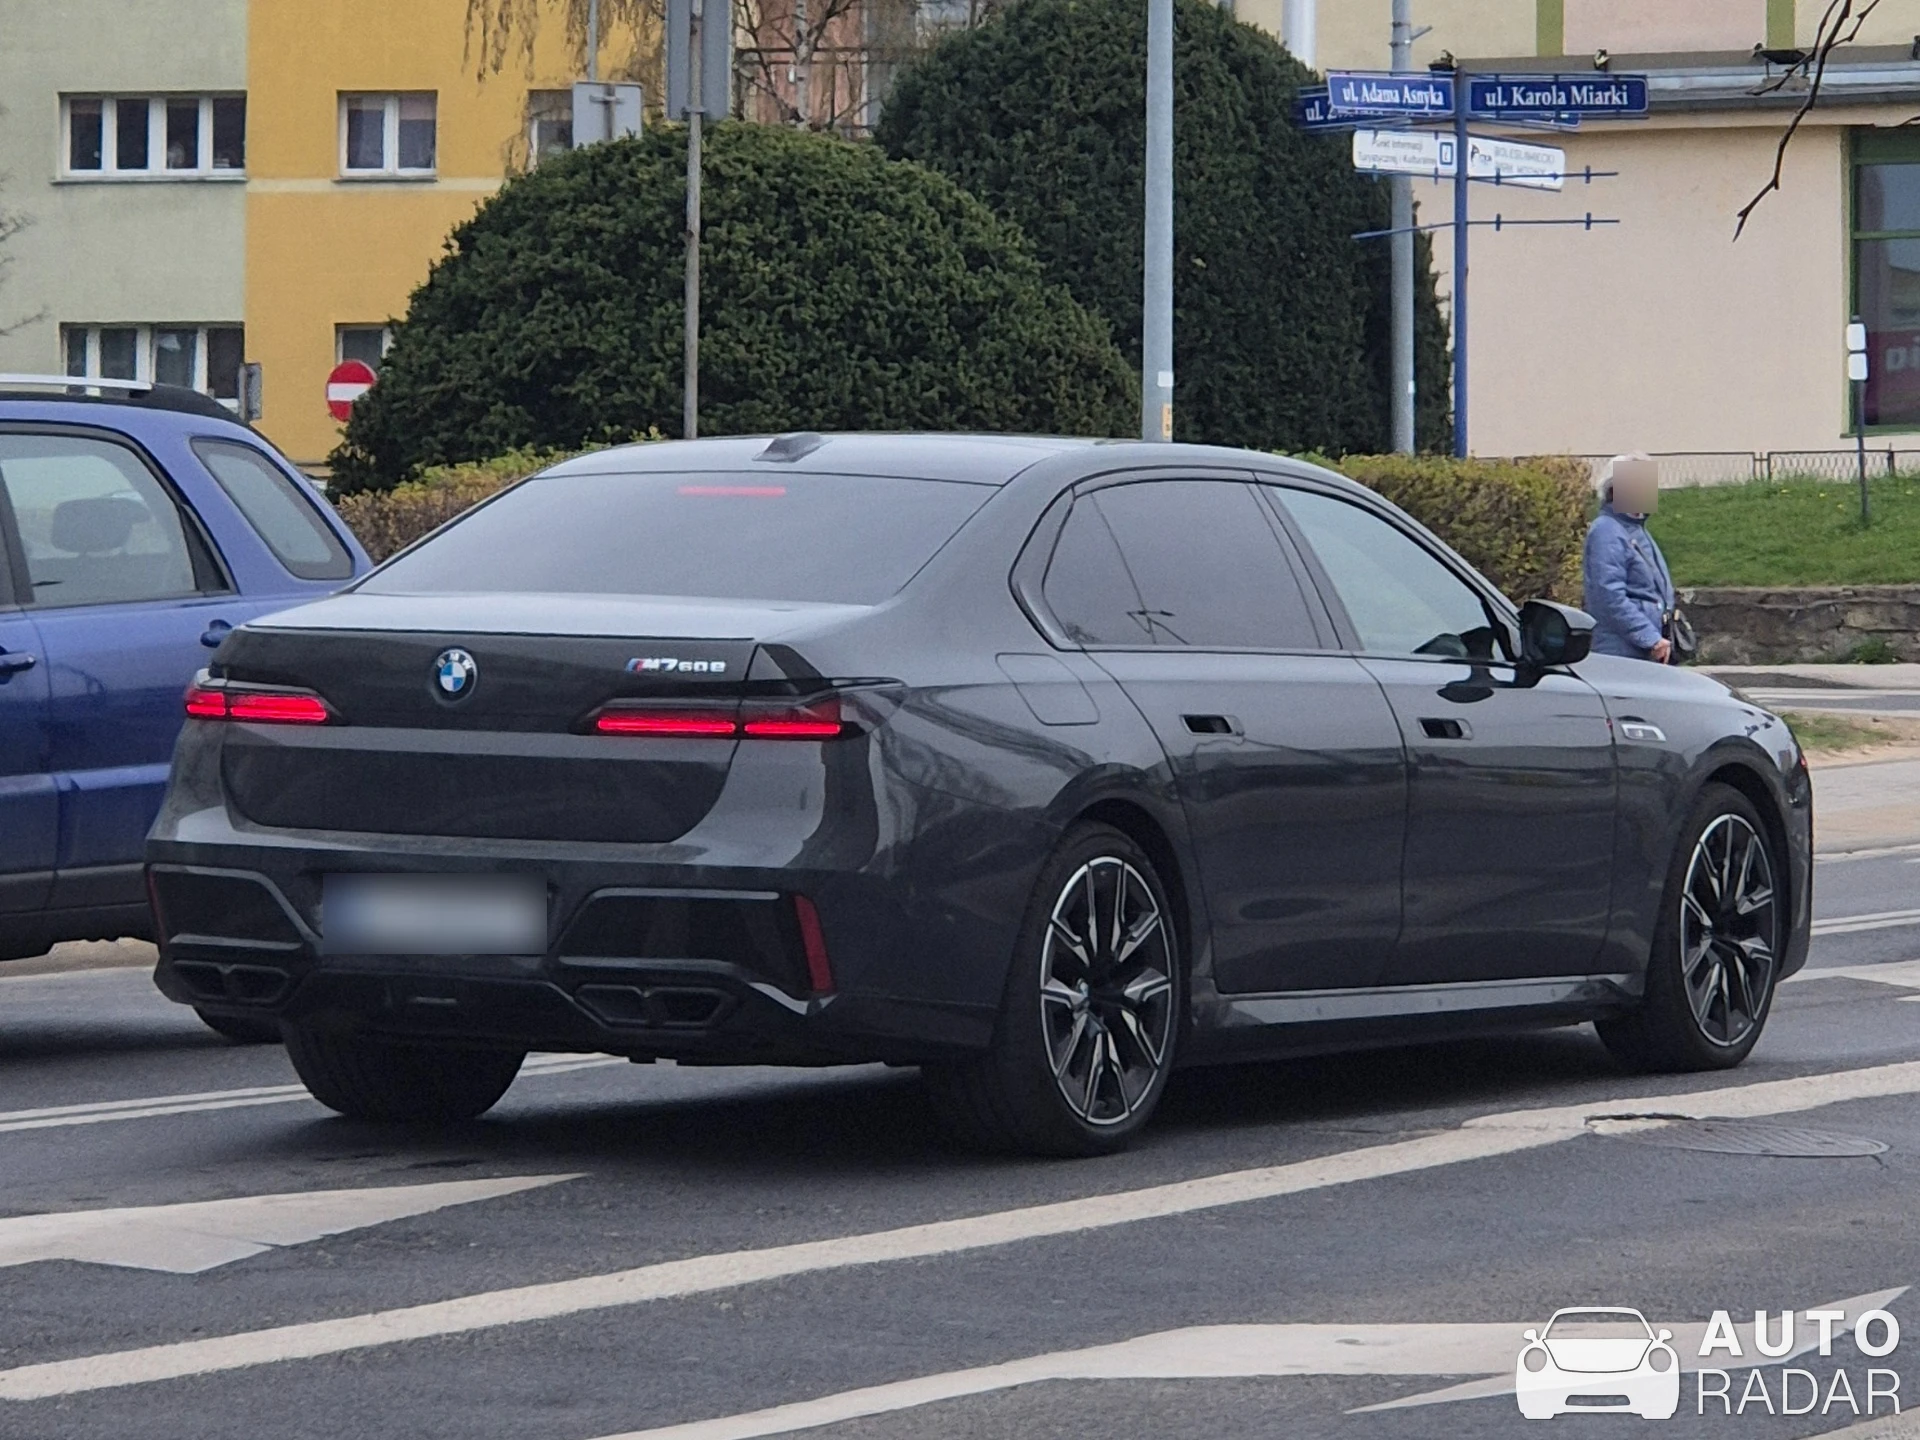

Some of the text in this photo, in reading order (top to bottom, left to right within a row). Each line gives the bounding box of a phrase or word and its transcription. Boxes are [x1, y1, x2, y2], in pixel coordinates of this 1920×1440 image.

[1361, 82, 1400, 103] Adama
[1402, 84, 1444, 111] Asnyka
[1485, 84, 1628, 106] ul. Karola Miarki
[1305, 100, 1324, 121] ul.
